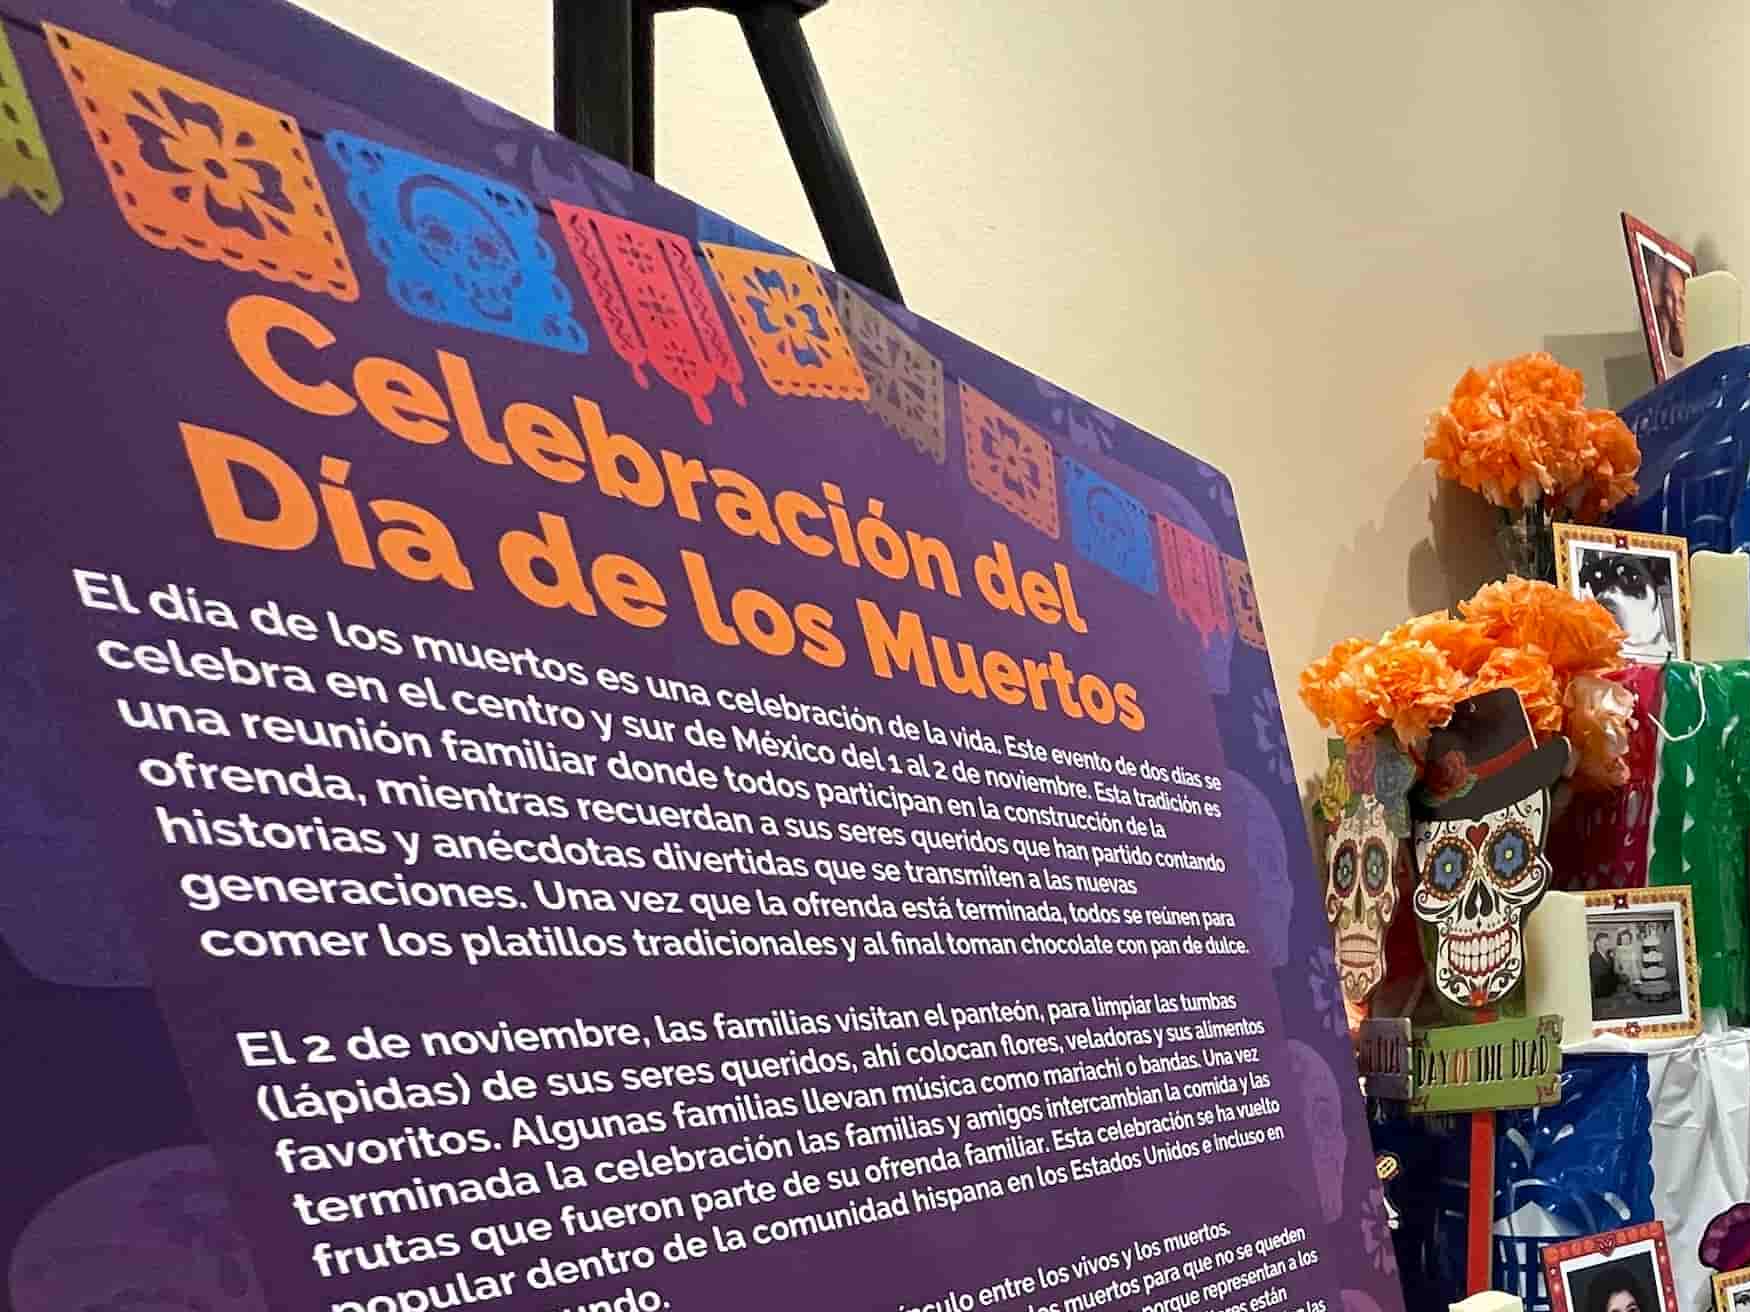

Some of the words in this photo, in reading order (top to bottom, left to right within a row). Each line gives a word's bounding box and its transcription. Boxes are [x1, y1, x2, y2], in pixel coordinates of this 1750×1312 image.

[225, 294, 958, 594] Celebración
[973, 541, 1085, 632] del
[179, 423, 473, 589] Día
[497, 510, 665, 628] de
[680, 551, 846, 666] los
[857, 599, 1143, 730] Muertos
[73, 568, 140, 614] El
[149, 583, 239, 629] día
[250, 600, 318, 641] de
[326, 611, 403, 655] los
[412, 634, 589, 686] muertos
[596, 668, 639, 694] es
[645, 676, 711, 707] una
[716, 687, 884, 735] celebración
[887, 714, 920, 741] de
[922, 719, 948, 746] la
[949, 726, 1002, 755] vida.
[1003, 734, 1048, 762] Este
[1051, 748, 1112, 773] evento
[1114, 755, 1137, 777] de
[1139, 759, 1170, 783] dos
[1203, 775, 1222, 791] se
[97, 639, 316, 693] celebra
[326, 671, 388, 703] en
[398, 677, 446, 711] el
[451, 690, 585, 730] centro
[590, 710, 612, 742] y
[622, 715, 675, 742] sur
[684, 719, 726, 749] de
[731, 725, 836, 764] México
[841, 742, 886, 772] del
[887, 754, 903, 774] 1
[906, 753, 931, 778] al
[932, 760, 948, 780] 2
[951, 759, 980, 784] de
[984, 769, 1092, 799] noviembre.
[1093, 780, 1132, 805] Esta
[1132, 787, 1202, 815] tradición
[1203, 801, 1222, 818] es
[236, 1030, 297, 1066] El
[302, 1035, 337, 1063] 2
[347, 1027, 410, 1060] de
[421, 1018, 650, 1056] noviembre,
[654, 1015, 707, 1043] las
[713, 1009, 831, 1040] familias
[834, 1006, 920, 1032] visitan
[923, 1002, 949, 1027] el
[950, 999, 1045, 1031] panteón,
[1046, 1001, 1091, 1025] para
[1091, 994, 1152, 1020] limpiar
[1153, 993, 1179, 1013] las
[1179, 991, 1237, 1011] tumbas
[1417, 1046, 1449, 1089] DAY
[1453, 1047, 1473, 1088] OF
[1476, 1043, 1505, 1084] THE
[1510, 1034, 1552, 1081] DEAD
[978, 1276, 1035, 1306] entre
[1037, 1266, 1070, 1288] los
[1071, 1252, 1120, 1278] vivos
[1120, 1248, 1131, 1270] y
[1133, 1240, 1161, 1261] los
[1163, 1222, 1231, 1253] muertos.
